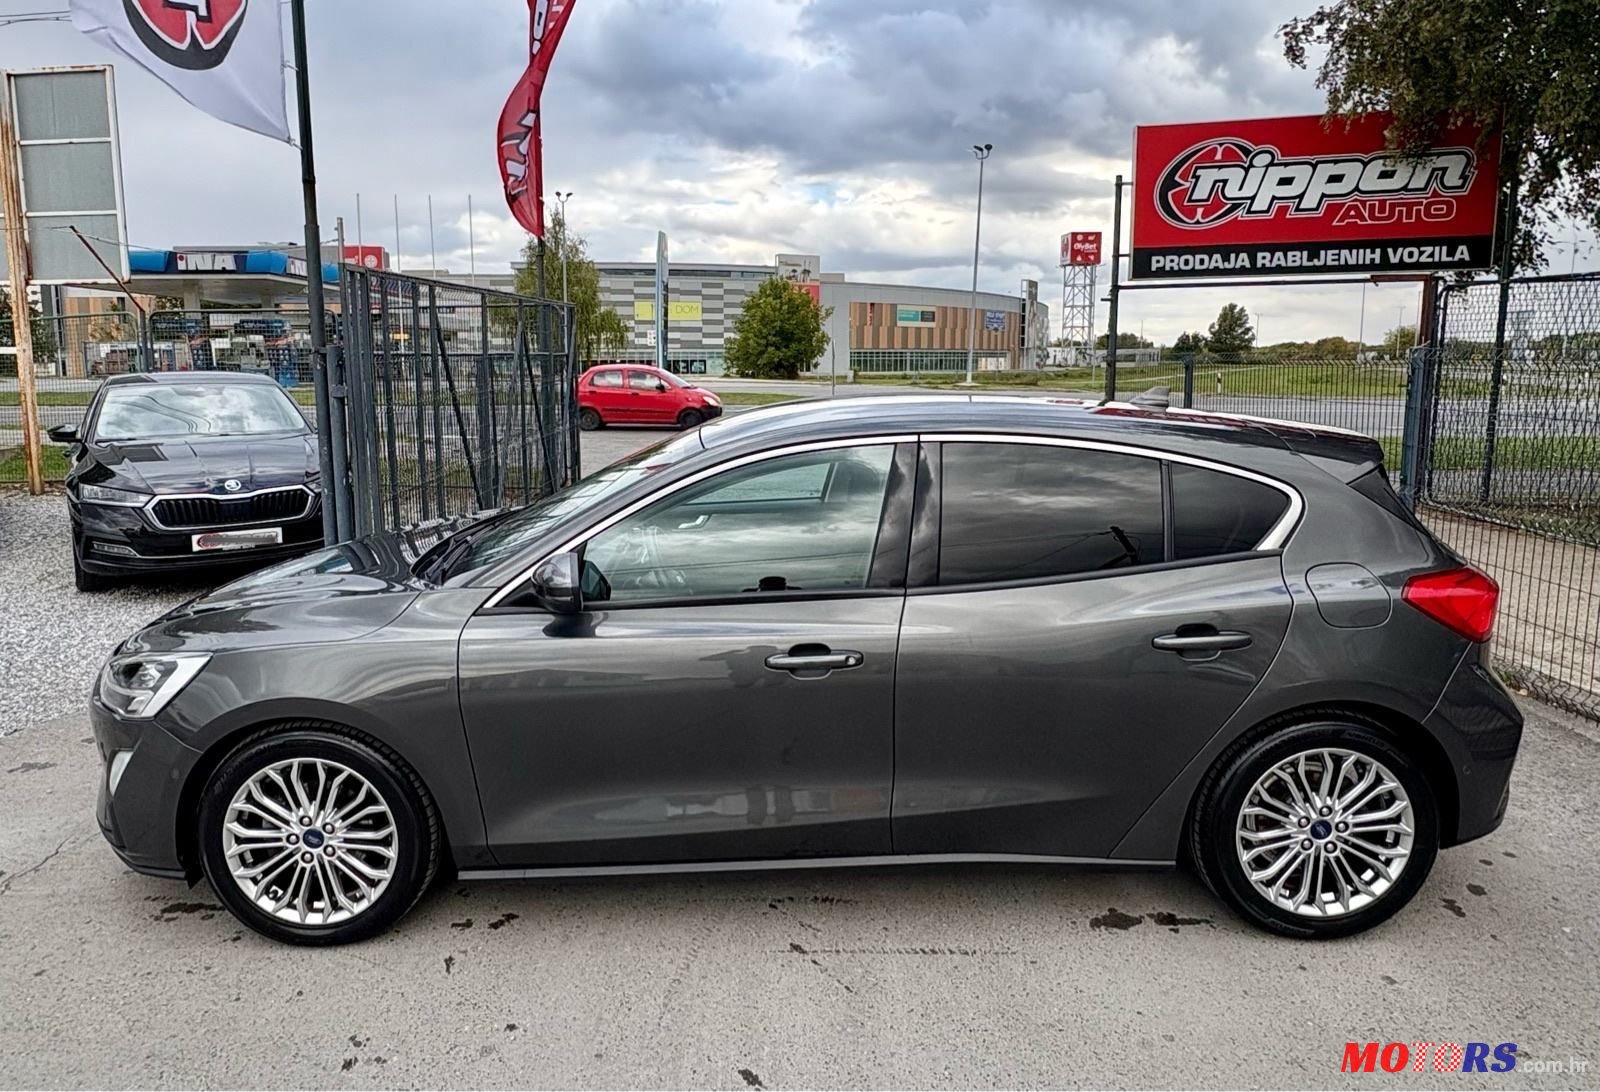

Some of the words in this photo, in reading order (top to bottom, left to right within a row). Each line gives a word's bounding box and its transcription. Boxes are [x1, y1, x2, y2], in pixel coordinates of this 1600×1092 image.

[1189, 150, 1472, 213] nippon
[1333, 199, 1457, 226] AUTO
[1150, 253, 1250, 272] PRODAJA
[1256, 248, 1382, 268] RABLJENIH
[1387, 245, 1471, 264] VOZILA
[675, 304, 699, 314] DOM
